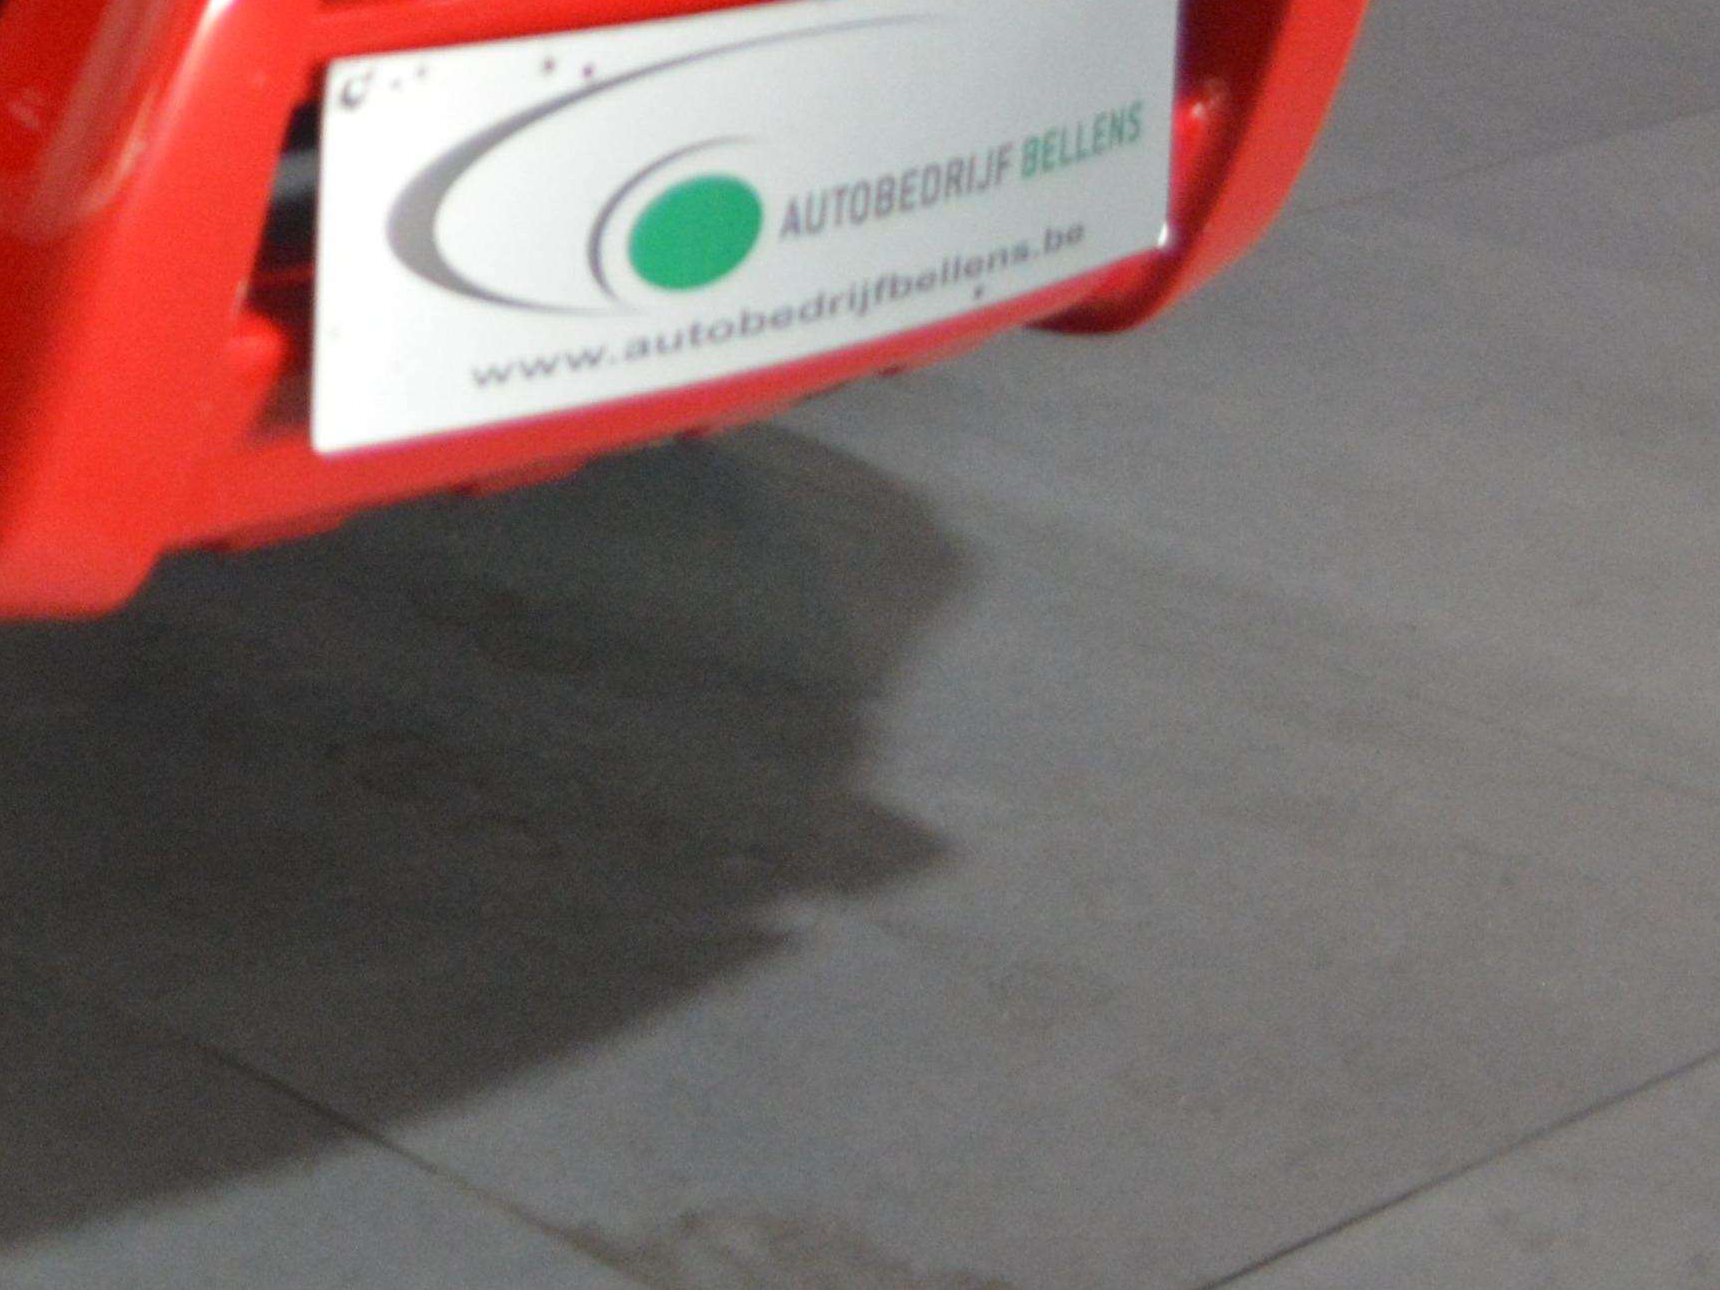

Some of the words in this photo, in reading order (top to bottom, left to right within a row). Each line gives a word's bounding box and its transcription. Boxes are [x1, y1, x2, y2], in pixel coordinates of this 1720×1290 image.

[778, 140, 1014, 239] AUTOBEDRIJF
[1019, 98, 1144, 179] BELLENS
[471, 221, 1086, 389] www.autobedrijfbellens.be
